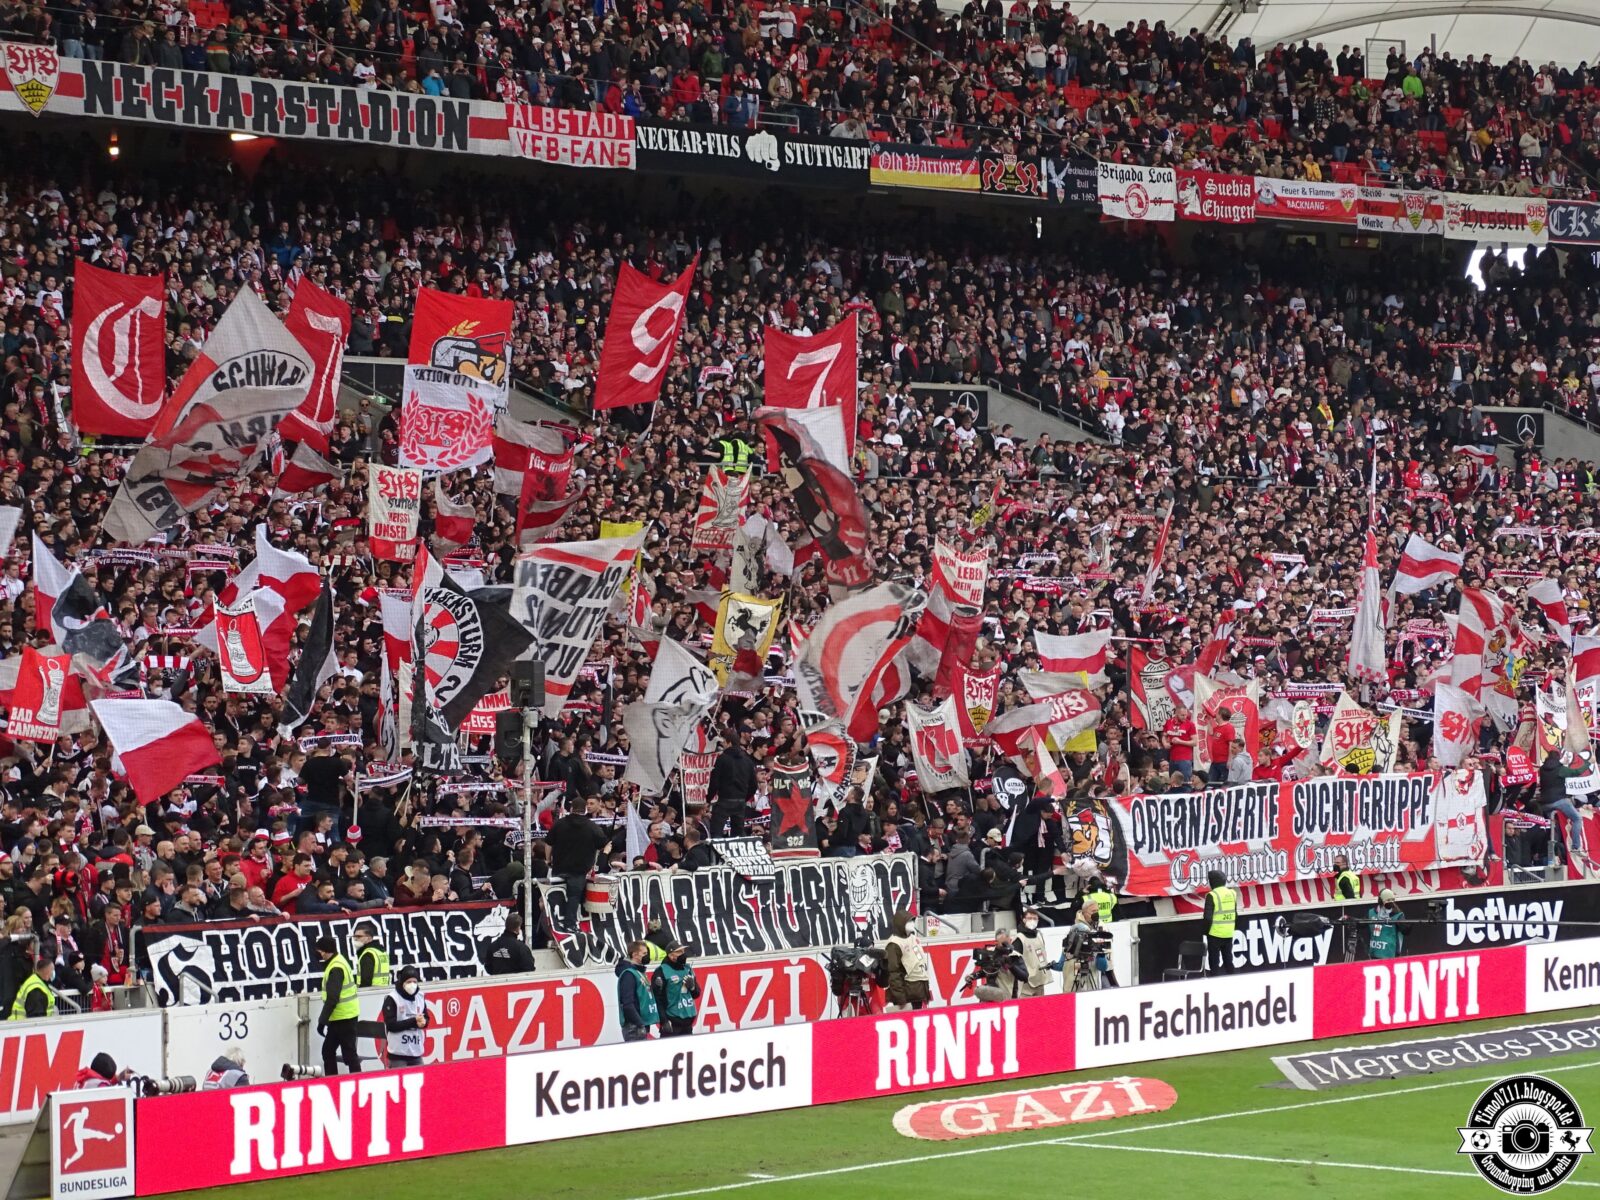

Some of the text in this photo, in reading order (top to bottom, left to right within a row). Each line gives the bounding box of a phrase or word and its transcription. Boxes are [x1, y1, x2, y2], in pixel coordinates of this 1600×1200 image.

[82, 60, 470, 151] NECKARSTADION
[512, 104, 633, 140] ALBSTADT
[636, 125, 741, 159] NECKAR-FILS
[784, 141, 871, 170] STUTTGART
[879, 150, 963, 175] Old Warriors
[1100, 163, 1173, 184] Brigada Loca
[1205, 178, 1250, 197] Suebia
[1281, 186, 1336, 197] Feuer & Flamme
[1203, 200, 1255, 222] Ehingen
[1286, 200, 1325, 210] BACKNANG
[629, 290, 684, 384] 9
[786, 342, 843, 409] 7
[374, 523, 407, 539] UNSER
[11, 707, 33, 723] BAD
[1293, 776, 1433, 834] SUCHTGRUPPE
[1203, 917, 1333, 968] etway
[1362, 955, 1480, 1028] RINTI
[218, 1011, 248, 1041] 33
[1094, 982, 1297, 1047] Im Fachhandel
[875, 1005, 1020, 1091] RINTI
[535, 1042, 786, 1118] Kennerfleisch
[229, 1072, 425, 1177] RINTI
[60, 1176, 127, 1194] BUNDESLIGA
